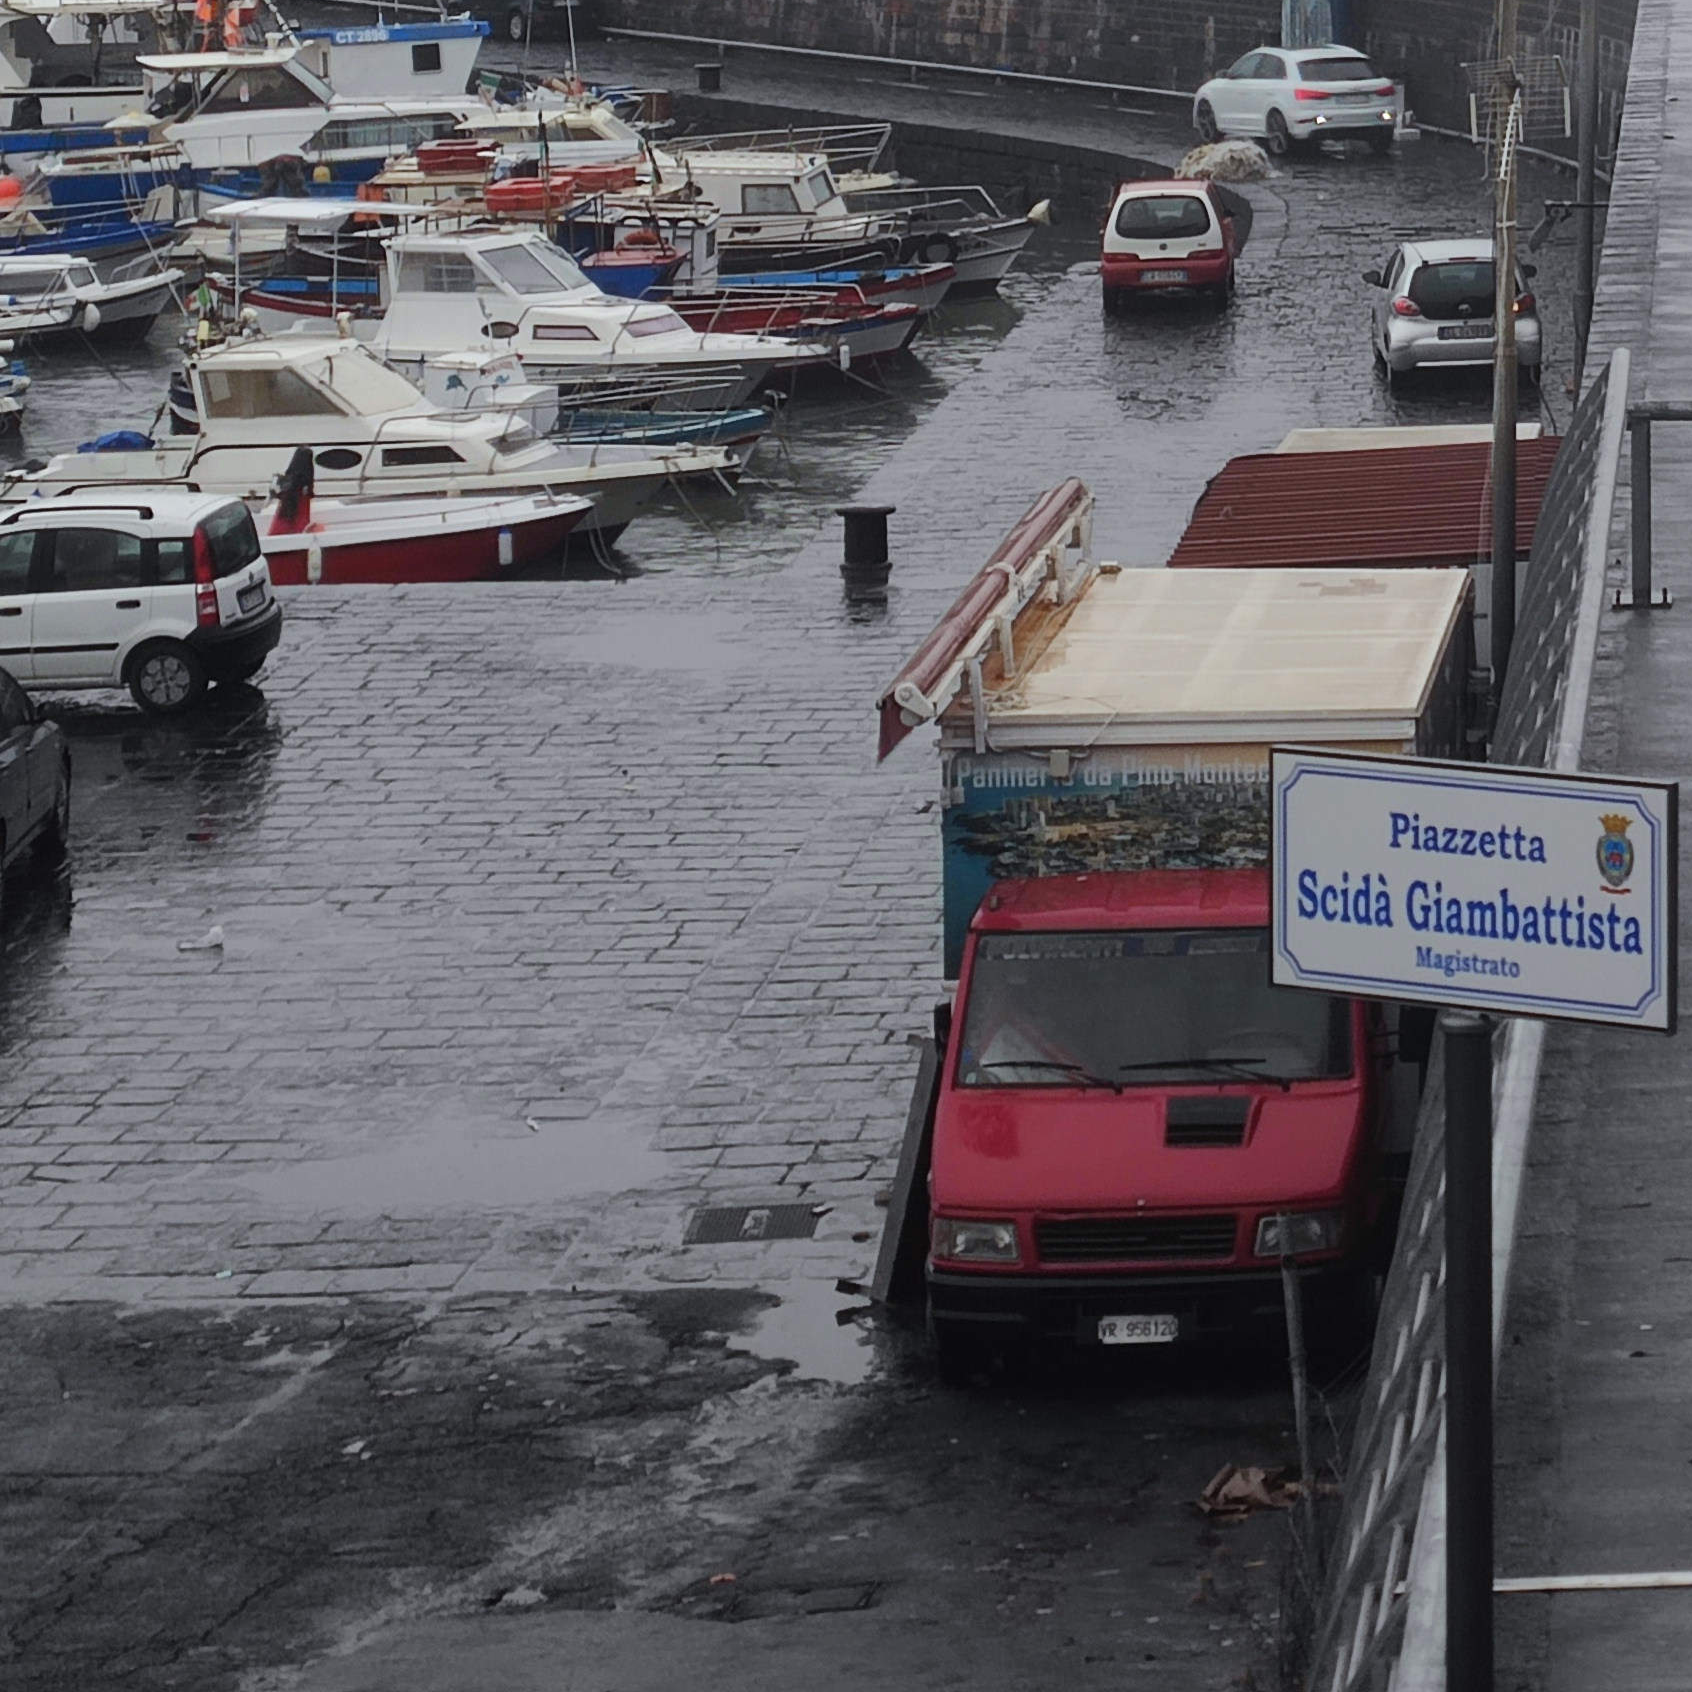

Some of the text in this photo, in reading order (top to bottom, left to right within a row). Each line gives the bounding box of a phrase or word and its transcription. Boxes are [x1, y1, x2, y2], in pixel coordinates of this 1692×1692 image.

[957, 758, 1074, 788] Paniner
[1083, 757, 1112, 787] da
[1121, 755, 1174, 787] Pino
[1389, 811, 1547, 864] Piazzetta
[1298, 868, 1643, 955] Scidà Giambattista
[1415, 945, 1521, 978] Magistrato
